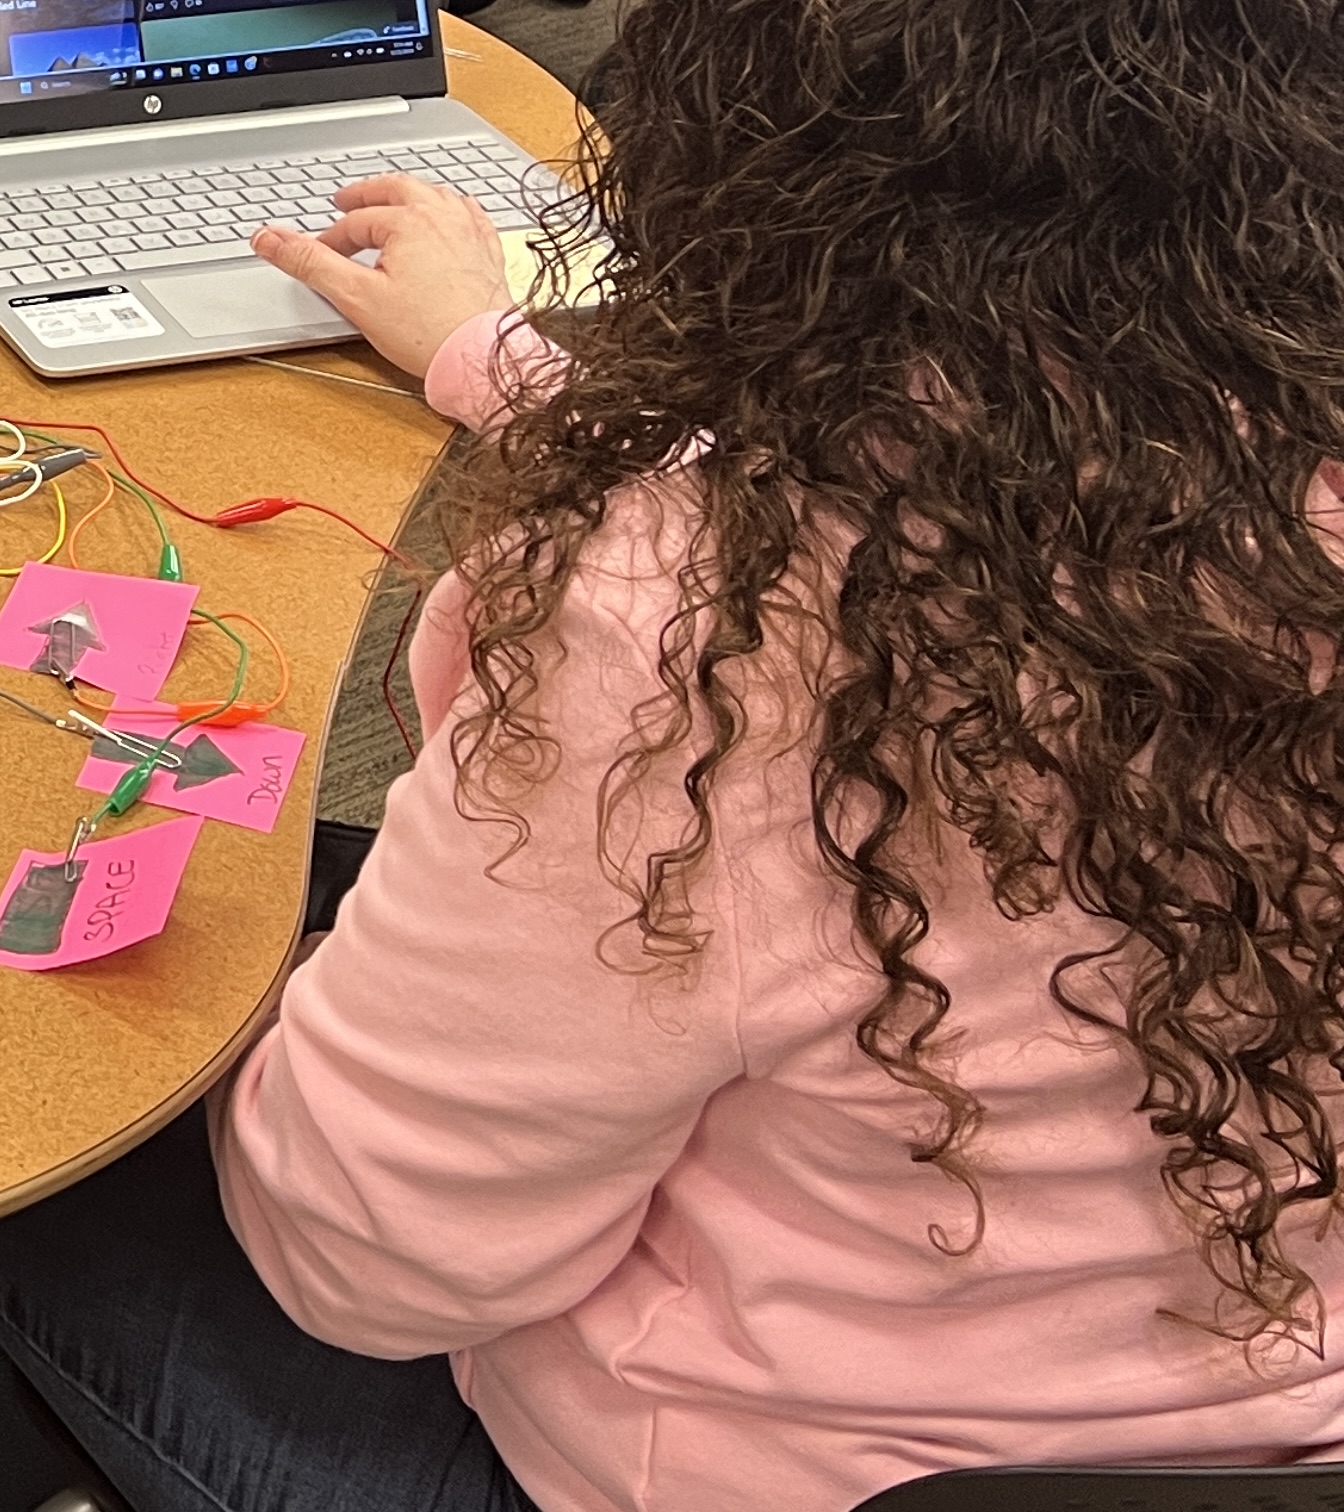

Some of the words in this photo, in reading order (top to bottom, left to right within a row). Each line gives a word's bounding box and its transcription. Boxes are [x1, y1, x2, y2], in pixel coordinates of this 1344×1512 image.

[16, 0, 37, 9] Line
[247, 754, 285, 806] Down
[83, 858, 136, 943] SPACE
